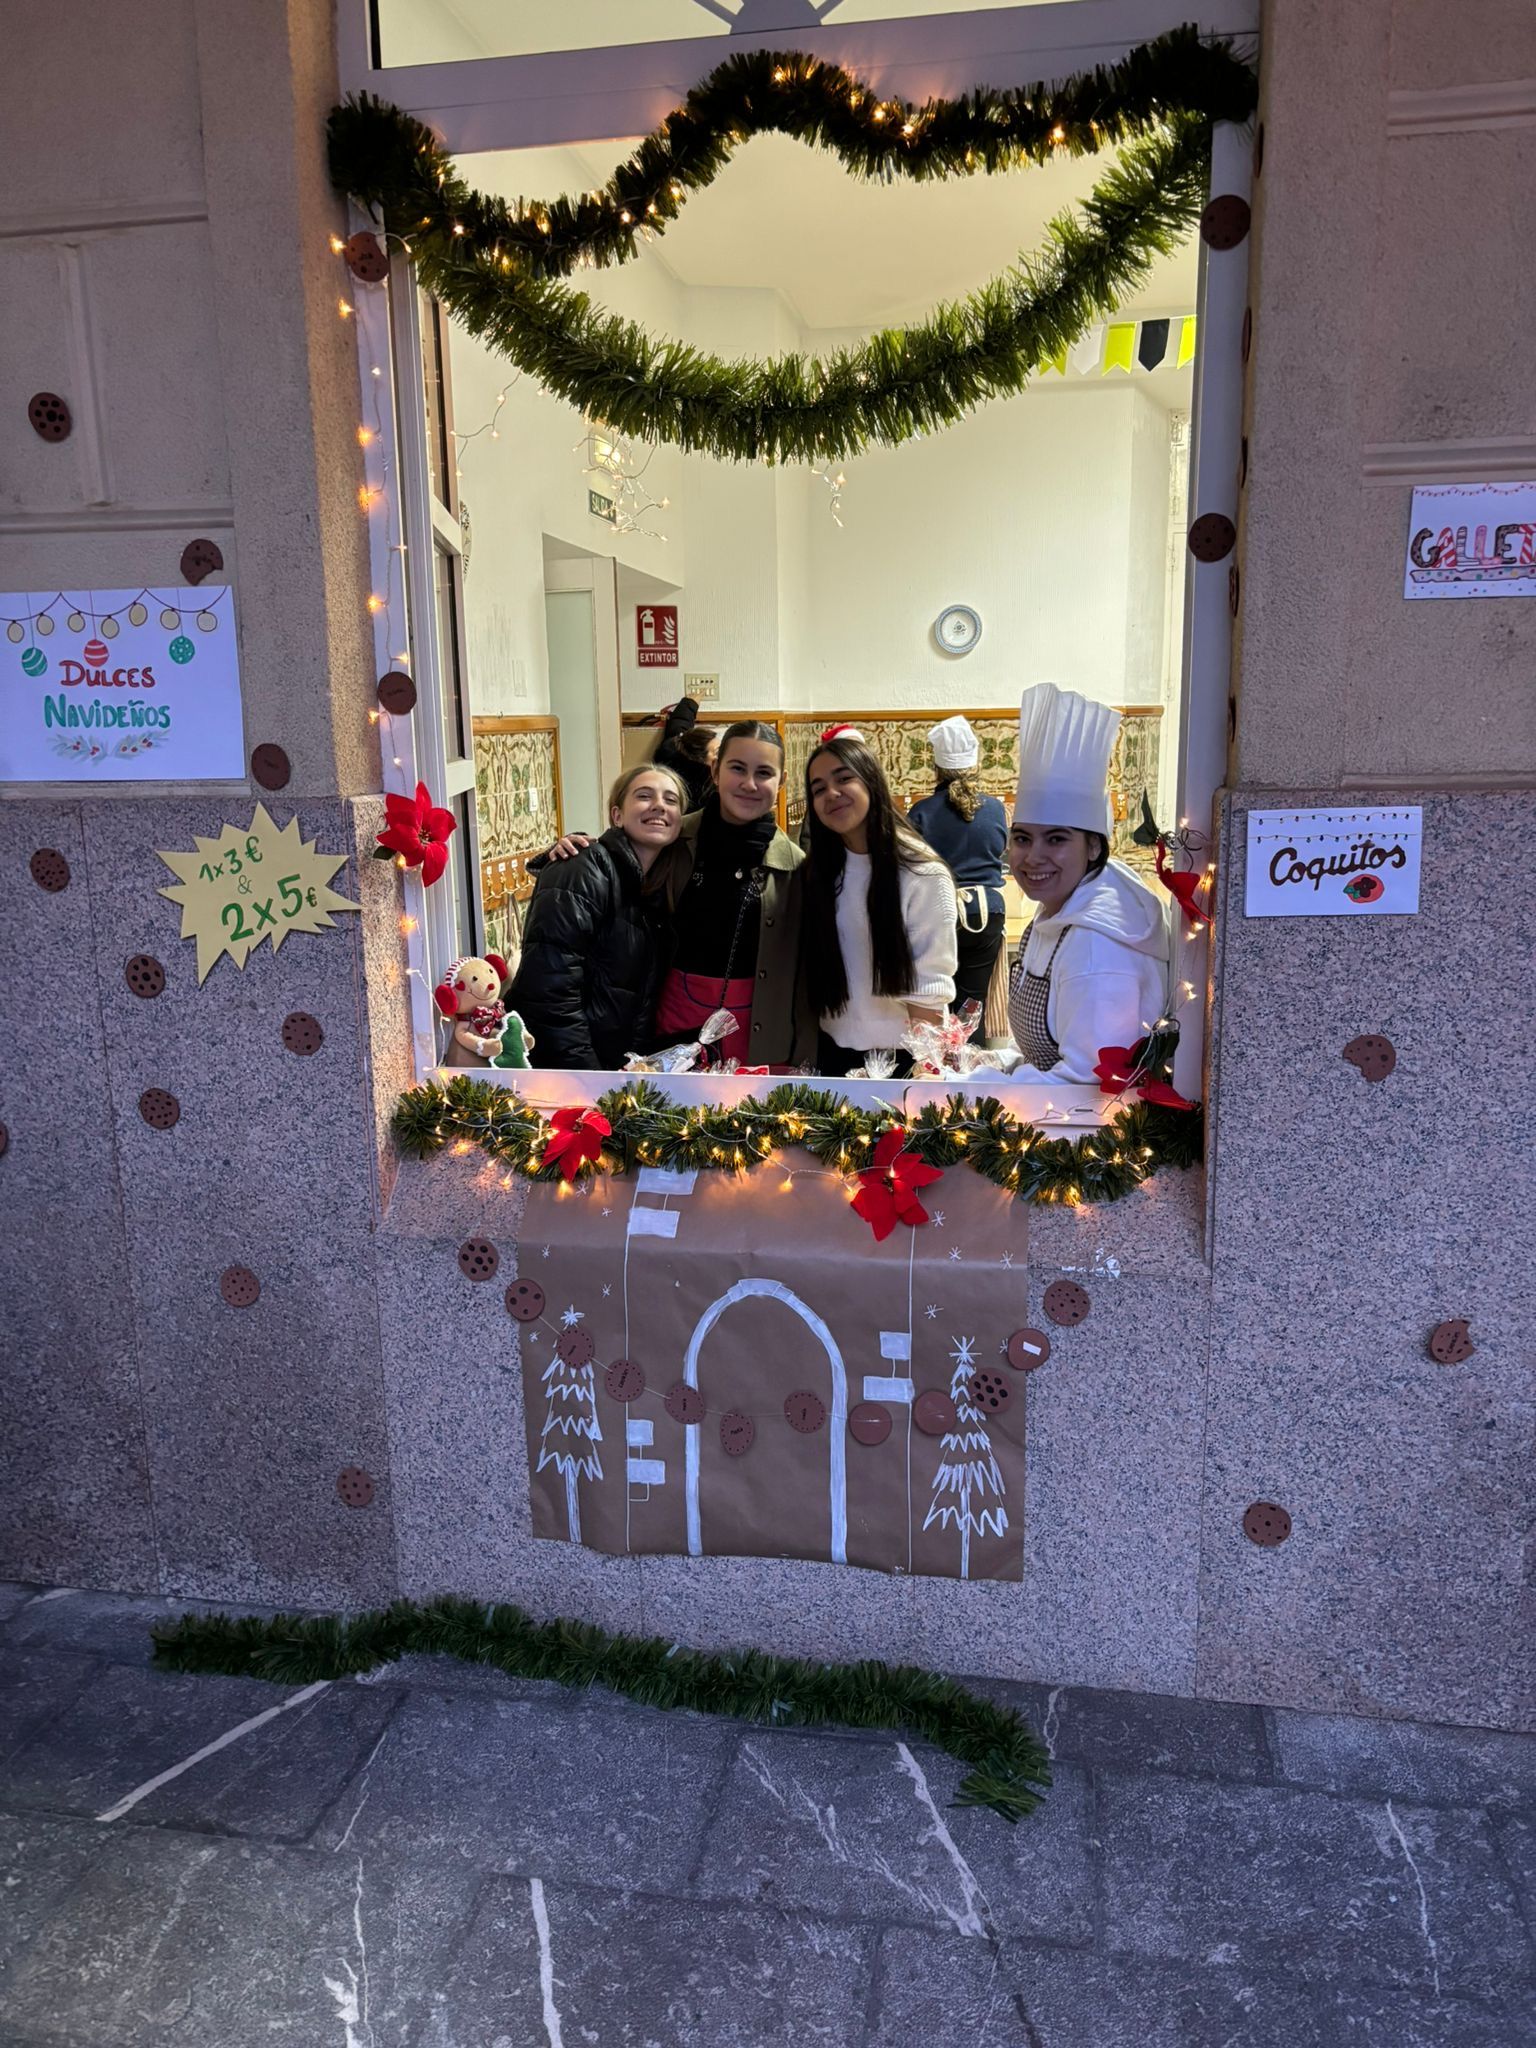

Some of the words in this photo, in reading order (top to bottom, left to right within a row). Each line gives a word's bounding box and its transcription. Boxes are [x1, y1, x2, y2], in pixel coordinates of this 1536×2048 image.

[640, 652, 677, 663] EXTINTOR
[58, 660, 156, 688] DULCES
[1269, 839, 1407, 891] Coquitos
[237, 874, 253, 895] &
